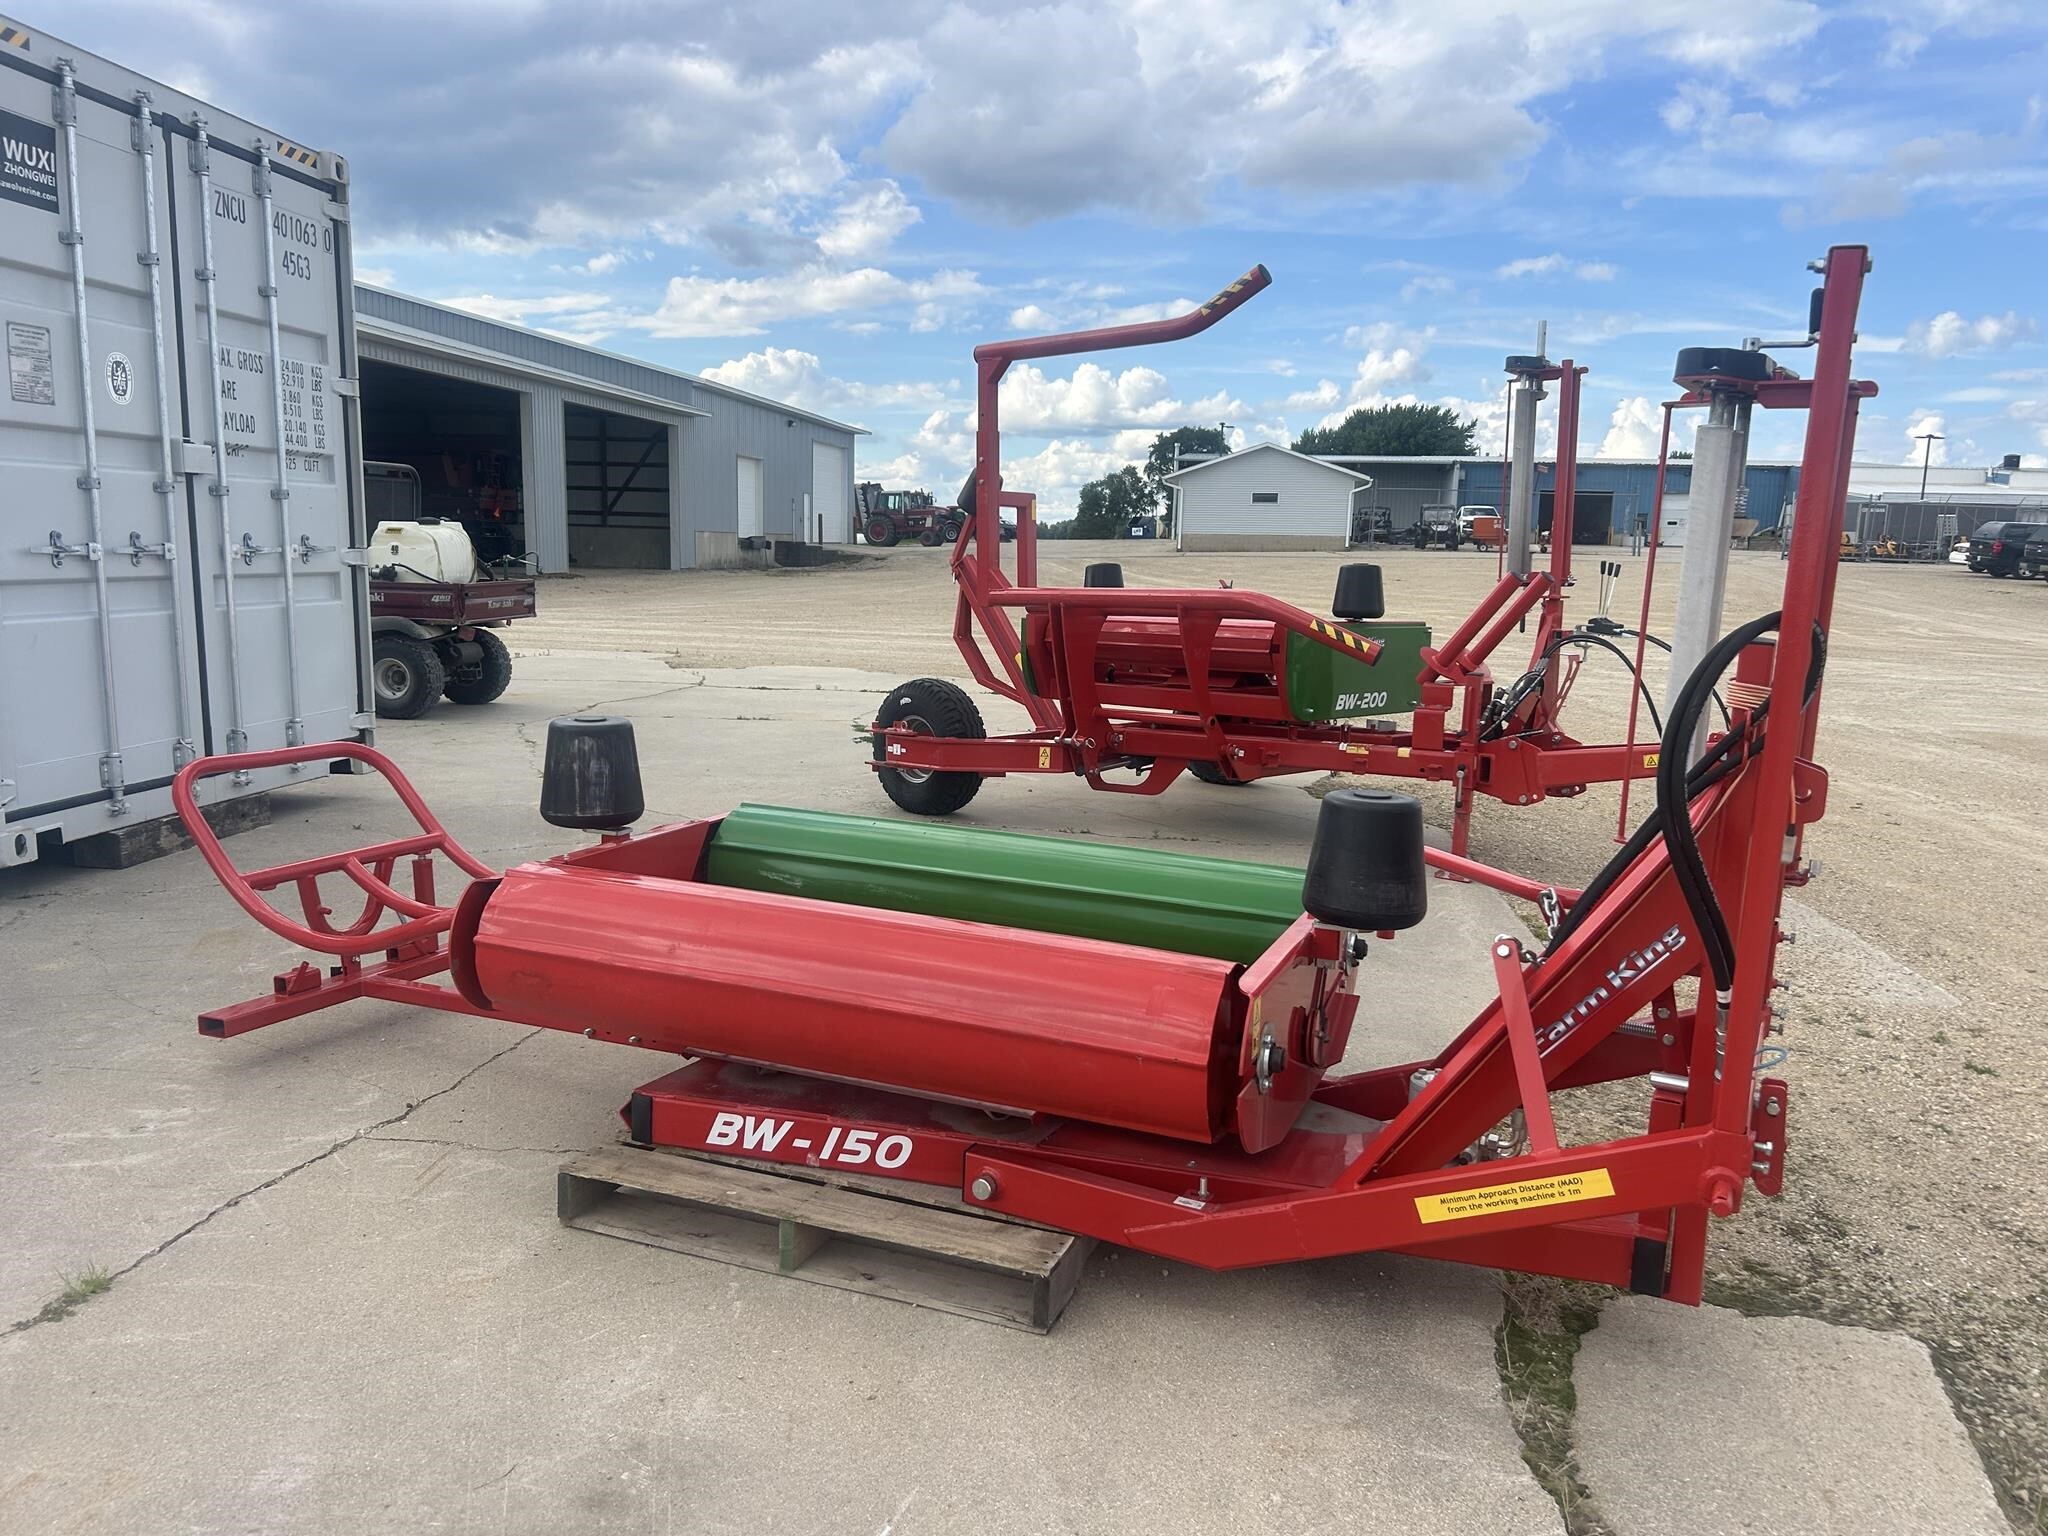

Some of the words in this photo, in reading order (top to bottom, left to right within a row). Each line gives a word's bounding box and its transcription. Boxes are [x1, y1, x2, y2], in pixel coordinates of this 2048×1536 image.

[2, 136, 55, 173] WUXI
[3, 162, 56, 187] ZHONGWEI
[214, 190, 246, 224] ZNCU
[273, 211, 317, 247] 401063
[282, 250, 311, 280] 45G3
[220, 346, 234, 368] AX.
[237, 350, 264, 374] GROSS
[311, 365, 323, 380] KGS
[221, 379, 237, 400] ARE
[312, 394, 323, 408] KGS
[311, 379, 322, 392] LBS
[223, 411, 256, 434] AYLOAD
[314, 423, 326, 436] KGS
[312, 408, 324, 421] LBS
[314, 436, 326, 449] LBS
[1335, 691, 1387, 711] BW-200
[1605, 923, 1687, 989] King
[1440, 1193, 1477, 1205] Minimum
[1478, 1187, 1517, 1200] Approach
[1518, 1182, 1555, 1193] Distance
[1557, 1177, 1583, 1188] (MAD)
[1447, 1205, 1468, 1213] from
[1468, 1203, 1483, 1211] the
[1484, 1198, 1519, 1208] working
[1519, 1192, 1556, 1203] machine
[1567, 1188, 1582, 1196] 1m
